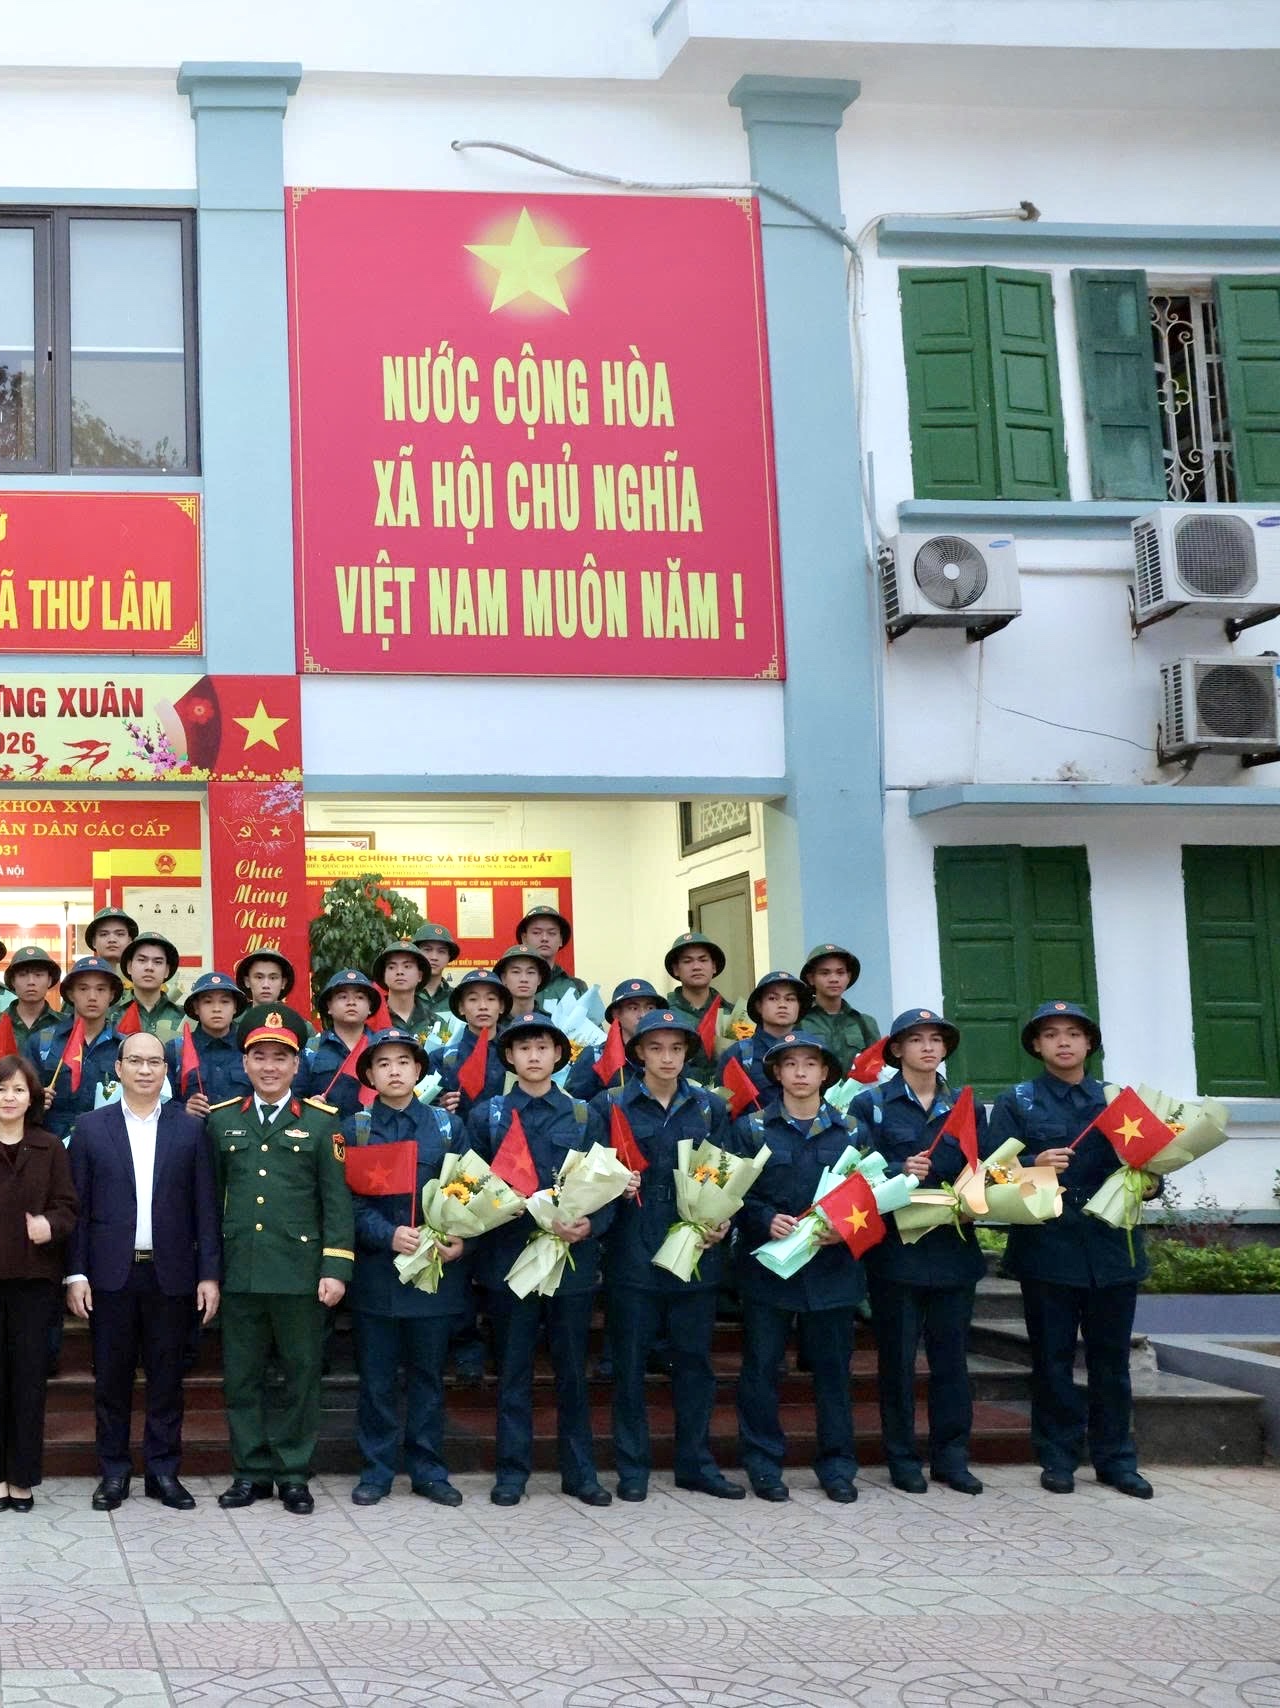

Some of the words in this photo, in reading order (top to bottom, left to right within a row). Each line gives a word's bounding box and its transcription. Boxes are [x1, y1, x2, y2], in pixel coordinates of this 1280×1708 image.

[382, 340, 479, 424] NƯỚC
[493, 343, 589, 439] CỘNG
[601, 346, 674, 426] HÒA
[373, 445, 420, 527] XÃ
[432, 445, 493, 544] HỘI
[507, 442, 580, 531] CHỦ
[593, 450, 703, 532] NGHĨA
[28, 574, 95, 630] THƯ
[102, 569, 172, 631] LÂM
[335, 549, 416, 650] VIỆT
[428, 568, 508, 636] NAM
[521, 552, 628, 638] MUÔN
[640, 558, 720, 639] NĂM
[57, 681, 144, 718] XUÂN
[62, 801, 100, 813] XVI
[33, 820, 77, 836] DÂN
[84, 822, 125, 836] CÁC
[130, 816, 170, 836] CẤP
[235, 859, 283, 879] Chúc
[321, 854, 354, 862] SÁCH
[358, 854, 398, 862] CHÍNH
[230, 884, 288, 908] Mừng
[235, 909, 287, 929] Năm
